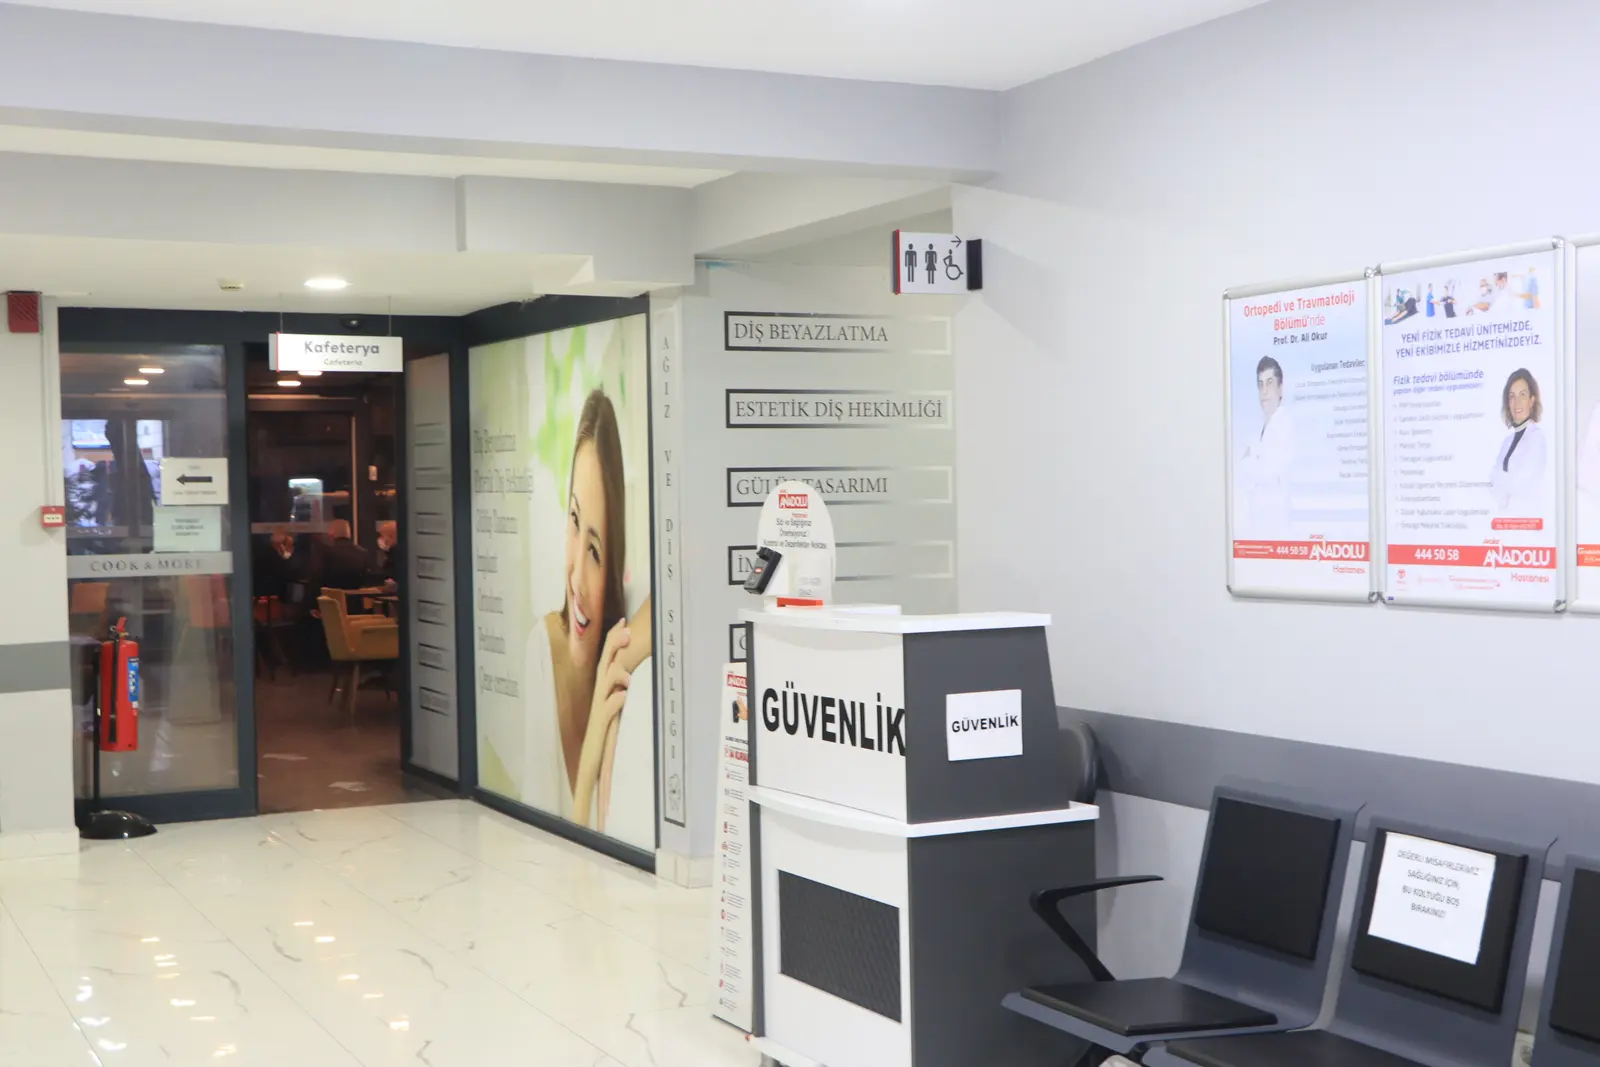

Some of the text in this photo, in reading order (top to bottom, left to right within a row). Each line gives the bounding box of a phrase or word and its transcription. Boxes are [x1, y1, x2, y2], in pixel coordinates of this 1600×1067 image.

[1244, 290, 1355, 317] Ortopedi ve Travmatoloji
[734, 320, 889, 343] DİŞ BEYAZLATMA
[1401, 330, 1419, 344] YENİ
[1422, 328, 1442, 342] FİZİK
[1444, 324, 1474, 338] TEDAVİ
[304, 341, 380, 357] Kafeterya
[1395, 345, 1414, 358] YENİ
[323, 358, 363, 366] Cafeteria
[1393, 375, 1411, 385] Fizik
[1412, 372, 1438, 384] tedavi
[735, 398, 943, 421] ESTETİK DİŞ HEKİMLİĞİ
[662, 335, 677, 760] AĞIZ VE DİŞ SAĞLIĞI
[1276, 546, 1289, 555] 444
[1290, 546, 1300, 556] 50
[1309, 540, 1366, 561] ANADOLU
[1414, 545, 1551, 569] 444 50 58 ANADOLU
[90, 560, 139, 572] COOK
[1511, 572, 1550, 583] Hastanesi
[762, 680, 906, 757] GÜVENLİK
[951, 712, 1020, 733] GÜVENLİK
